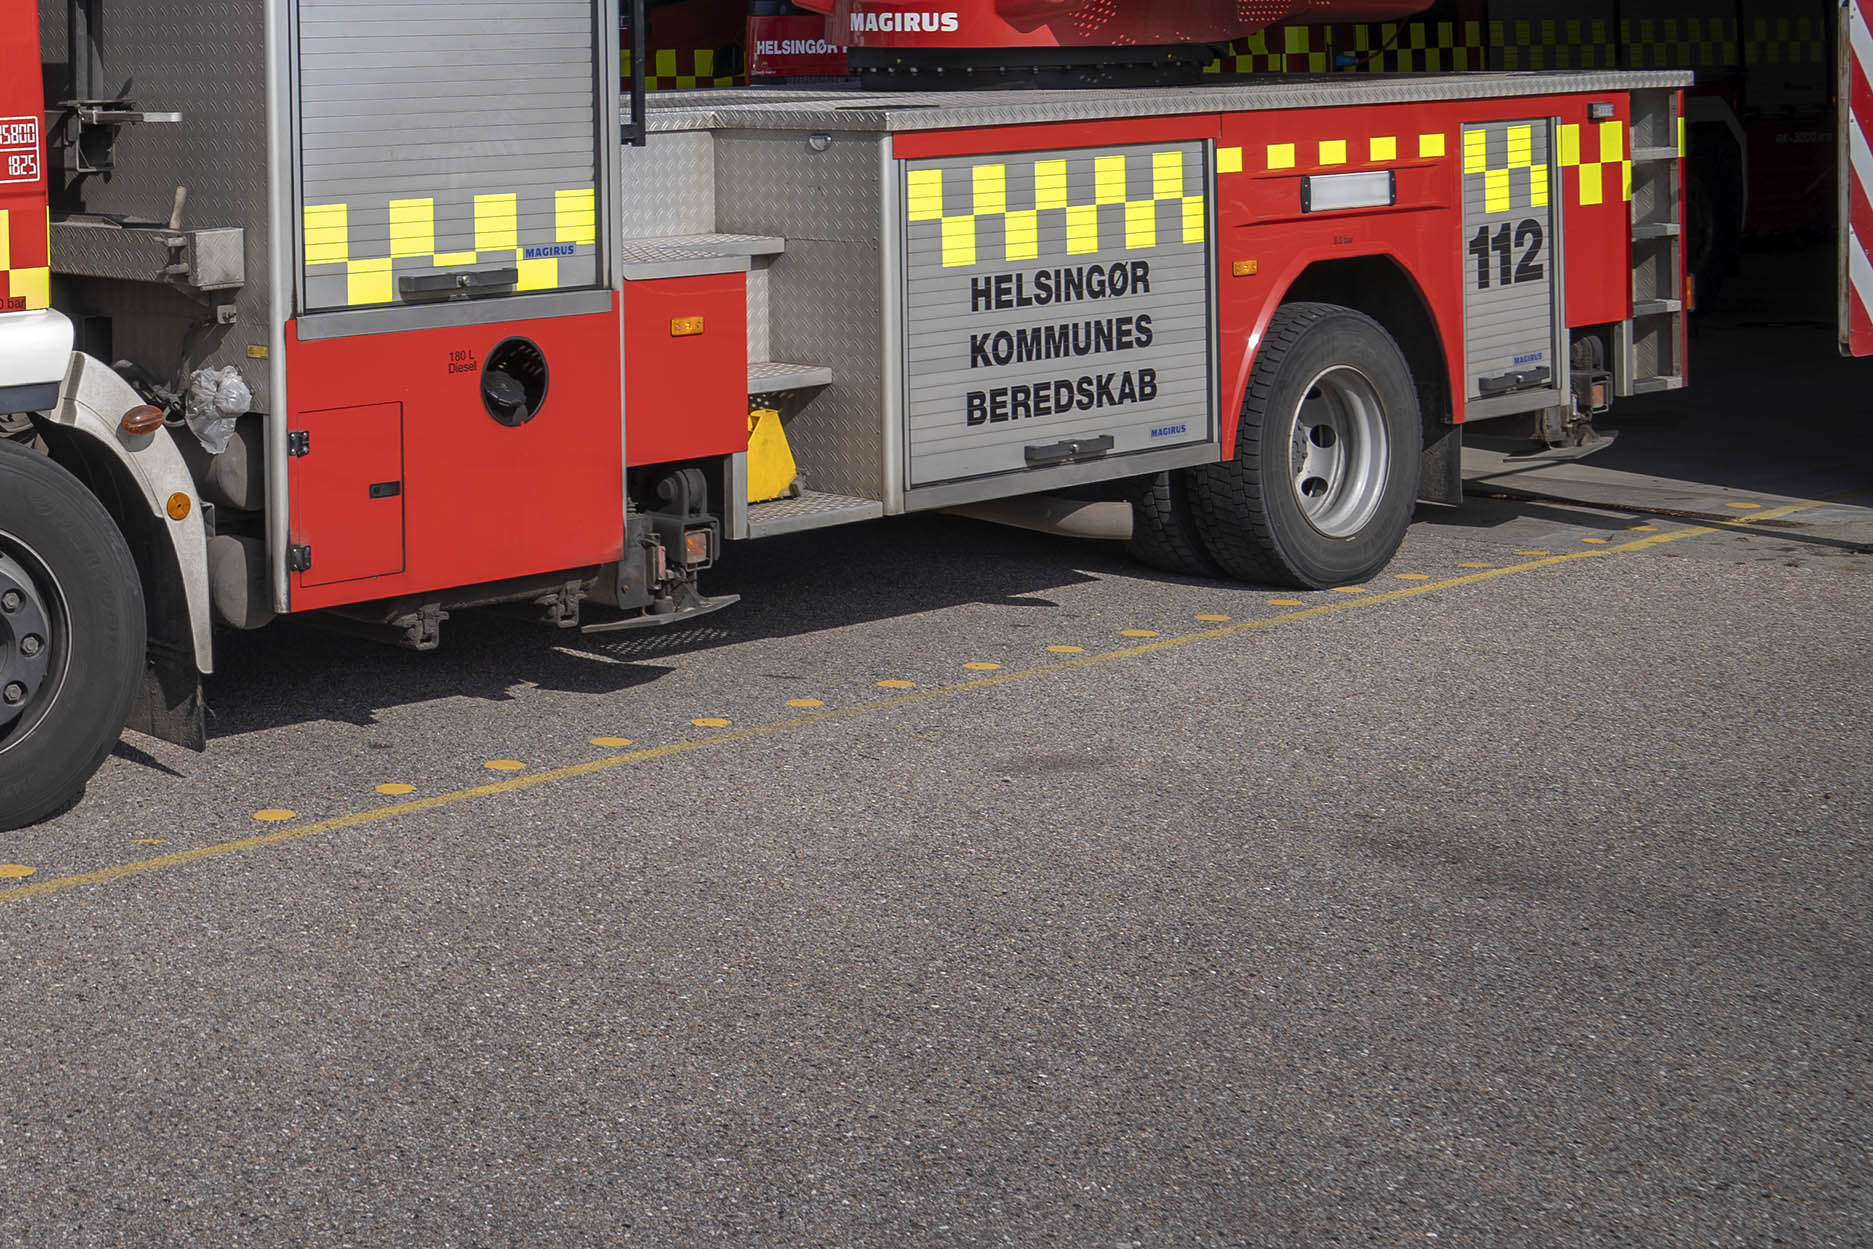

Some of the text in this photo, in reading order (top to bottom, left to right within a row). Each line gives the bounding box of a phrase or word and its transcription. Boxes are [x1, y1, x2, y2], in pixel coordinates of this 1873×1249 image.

[850, 12, 959, 32] MAGIRUS
[8, 154, 37, 176] 1825
[525, 245, 575, 258] MAGIRUS
[1468, 218, 1544, 289] 112
[970, 260, 1151, 312] HELSINGØR
[7, 297, 25, 309] bar
[970, 313, 1154, 368] KOMMUNES
[449, 349, 475, 362] 180 L
[448, 360, 477, 373] Diesel
[966, 367, 1158, 427] BEREDSKAB
[1151, 423, 1187, 438] MAGIRUS
